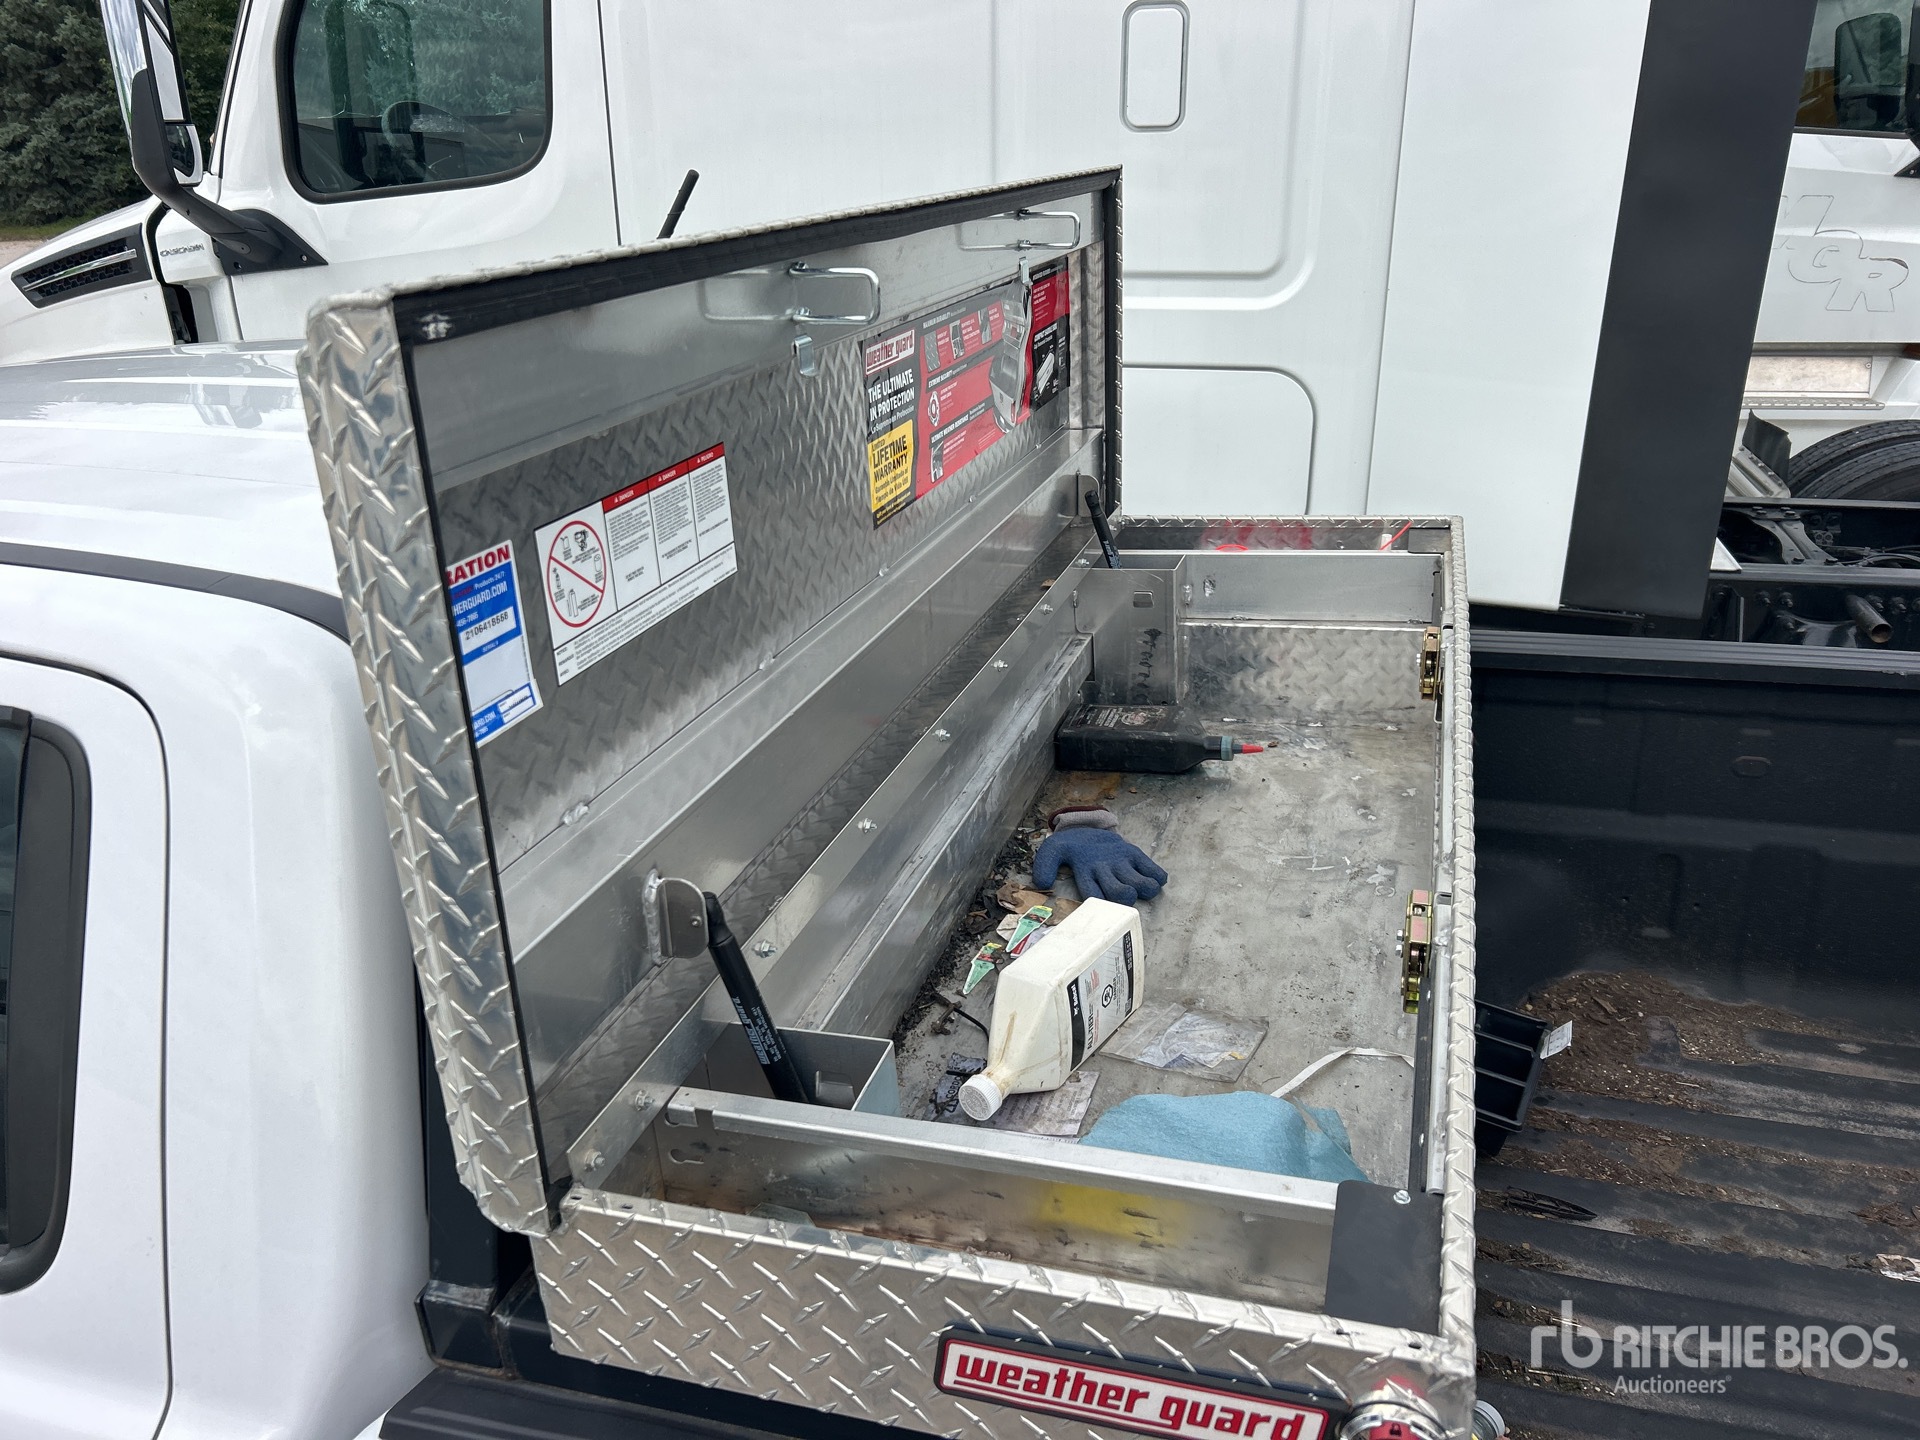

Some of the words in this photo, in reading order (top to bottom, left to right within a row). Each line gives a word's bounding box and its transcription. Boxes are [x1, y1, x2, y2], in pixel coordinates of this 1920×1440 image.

[867, 341, 894, 366] weather
[896, 334, 914, 356] guard
[868, 384, 881, 403] THE
[882, 368, 914, 392] ULTIMATE
[869, 405, 878, 421] IN
[878, 386, 915, 417] PROTECTION
[872, 435, 907, 468] LIFETIME
[874, 452, 908, 482] WARRANTY
[662, 470, 676, 481] DANGER
[619, 490, 634, 502] DANGER
[745, 1025, 770, 1065] weather
[956, 1354, 1150, 1414] weather
[1160, 1395, 1306, 1440] guard
